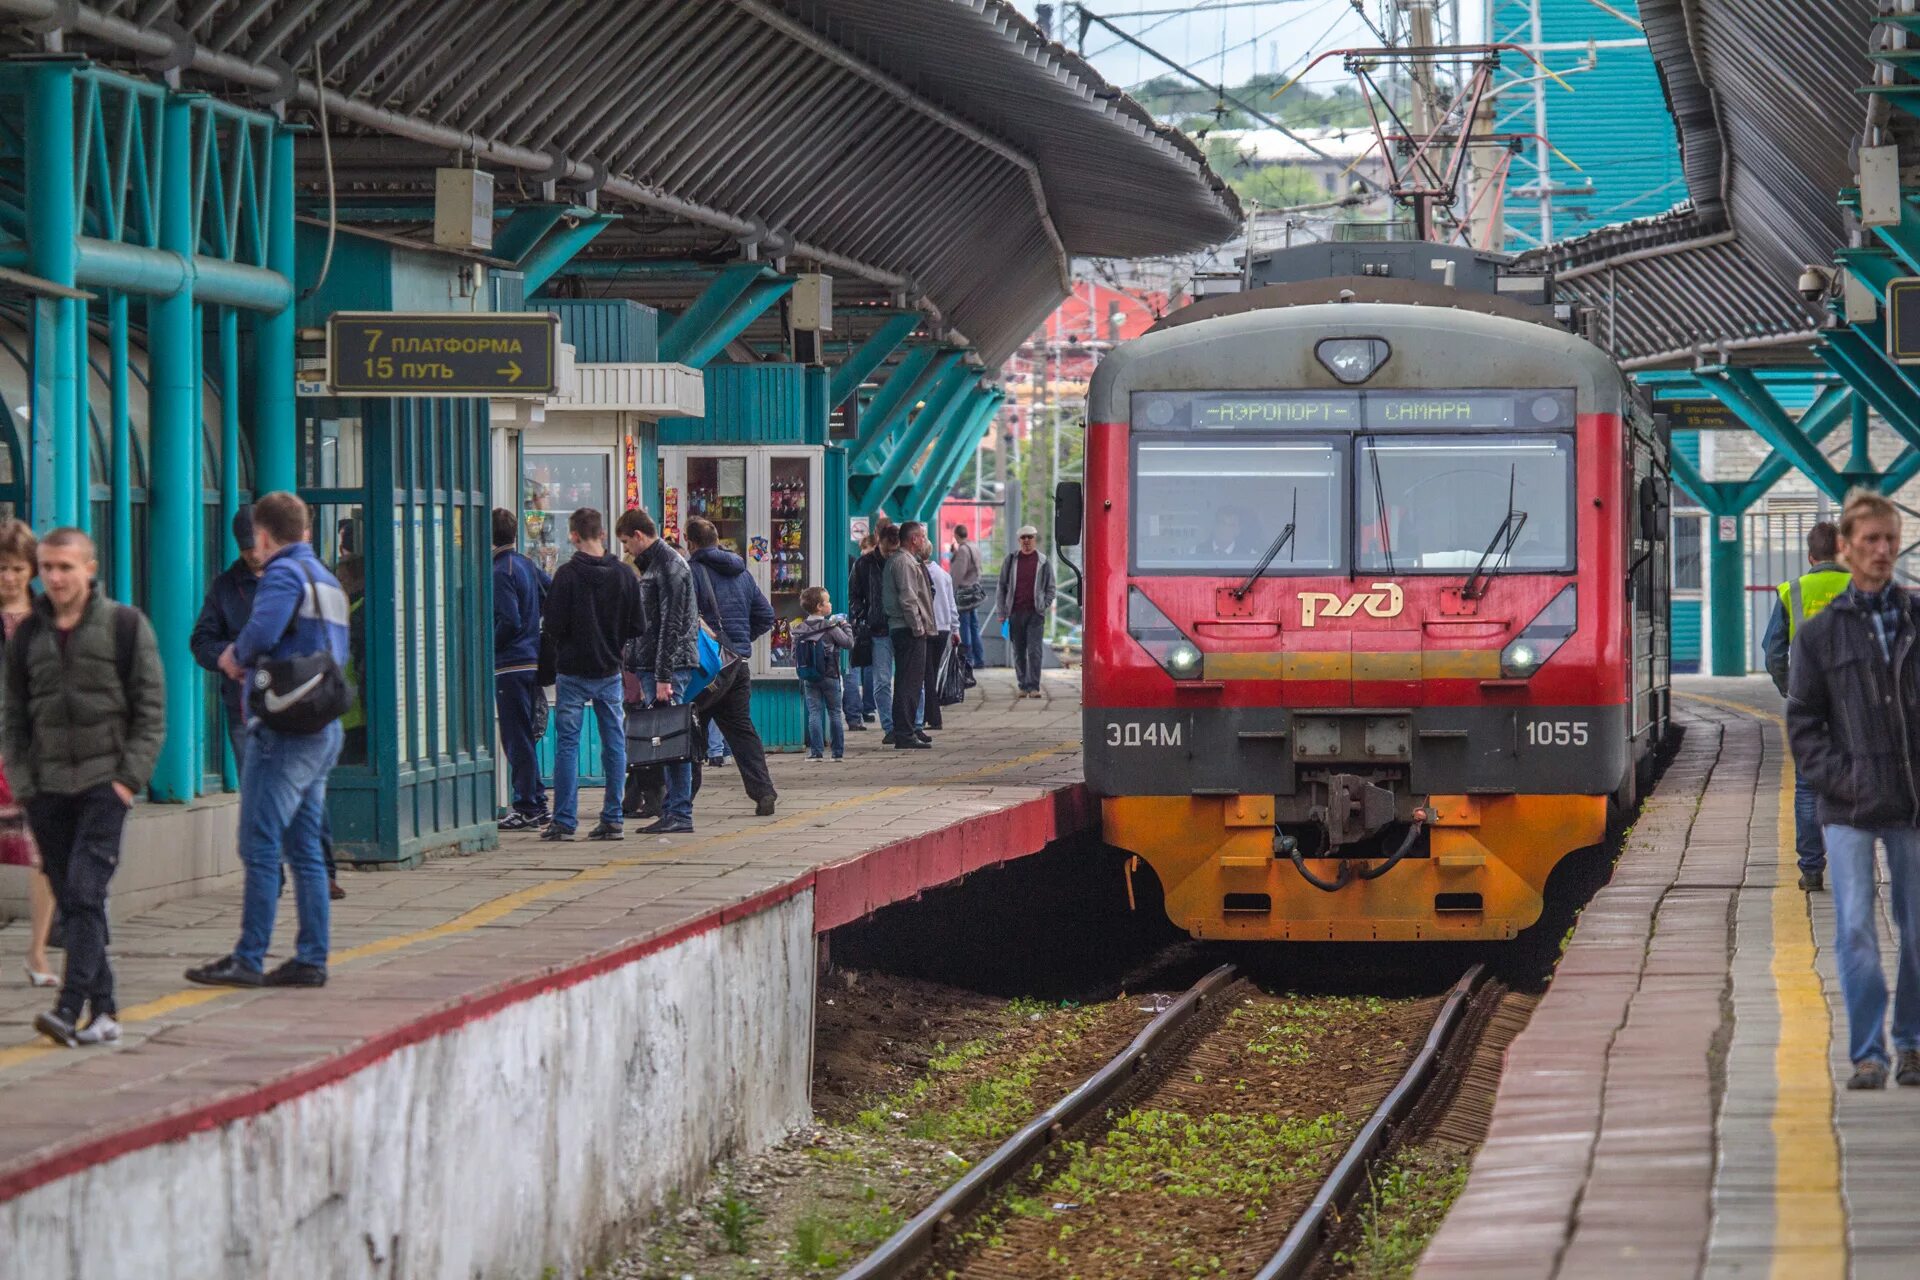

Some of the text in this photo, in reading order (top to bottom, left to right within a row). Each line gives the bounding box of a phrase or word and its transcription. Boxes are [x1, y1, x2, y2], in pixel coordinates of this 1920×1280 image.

[364, 329, 522, 353] 7 ПЛАТФОРМА
[364, 357, 454, 379] 15 ПУТЬ
[1386, 402, 1471, 421] САМАРА
[1297, 582, 1404, 627] РЖД
[1106, 722, 1182, 746] ЭД4М
[1526, 721, 1589, 746] 1055
